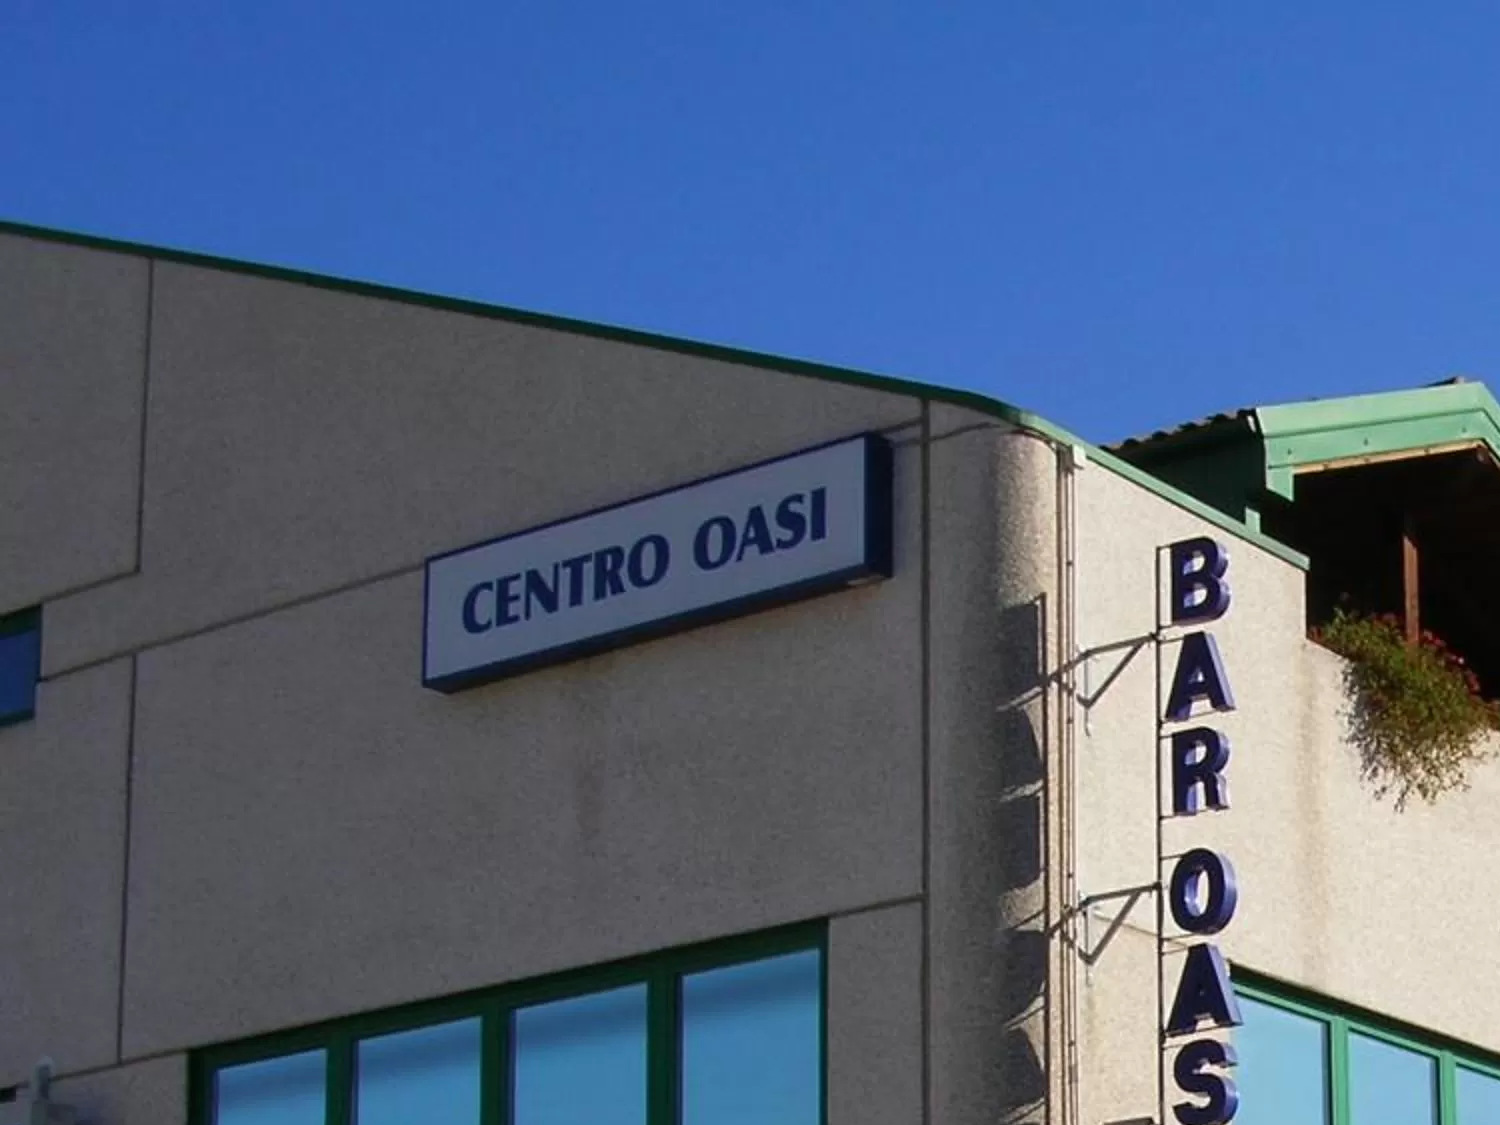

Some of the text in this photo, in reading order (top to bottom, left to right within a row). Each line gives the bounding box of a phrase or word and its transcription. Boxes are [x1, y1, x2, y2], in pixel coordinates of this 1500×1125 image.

[462, 487, 827, 634] CENTRO OASI
[1166, 535, 1236, 816] BAR
